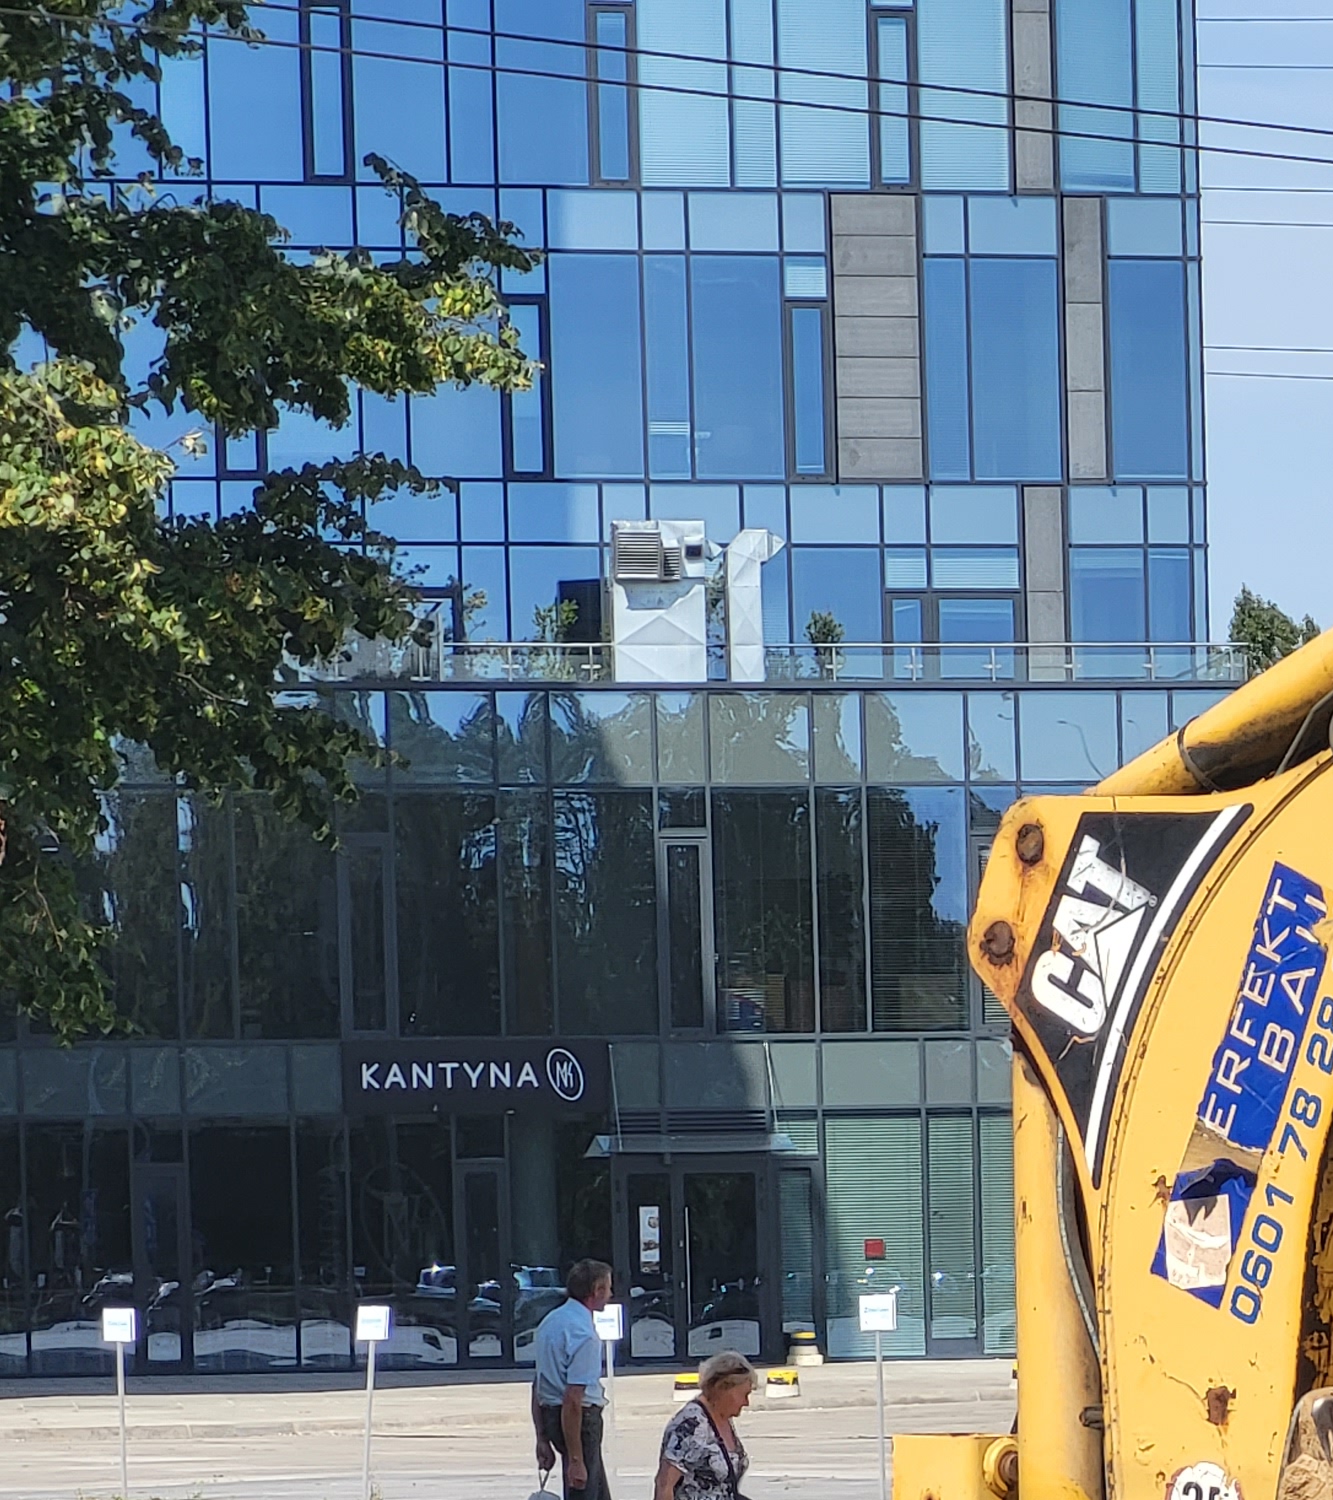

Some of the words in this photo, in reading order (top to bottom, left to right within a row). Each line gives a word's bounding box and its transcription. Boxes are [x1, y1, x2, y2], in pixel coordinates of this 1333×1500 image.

[1032, 834, 1152, 1034] CAT
[360, 1061, 540, 1090] KANTYNA
[1230, 1189, 1296, 1326] 0601
[1278, 1091, 1323, 1161] 78
